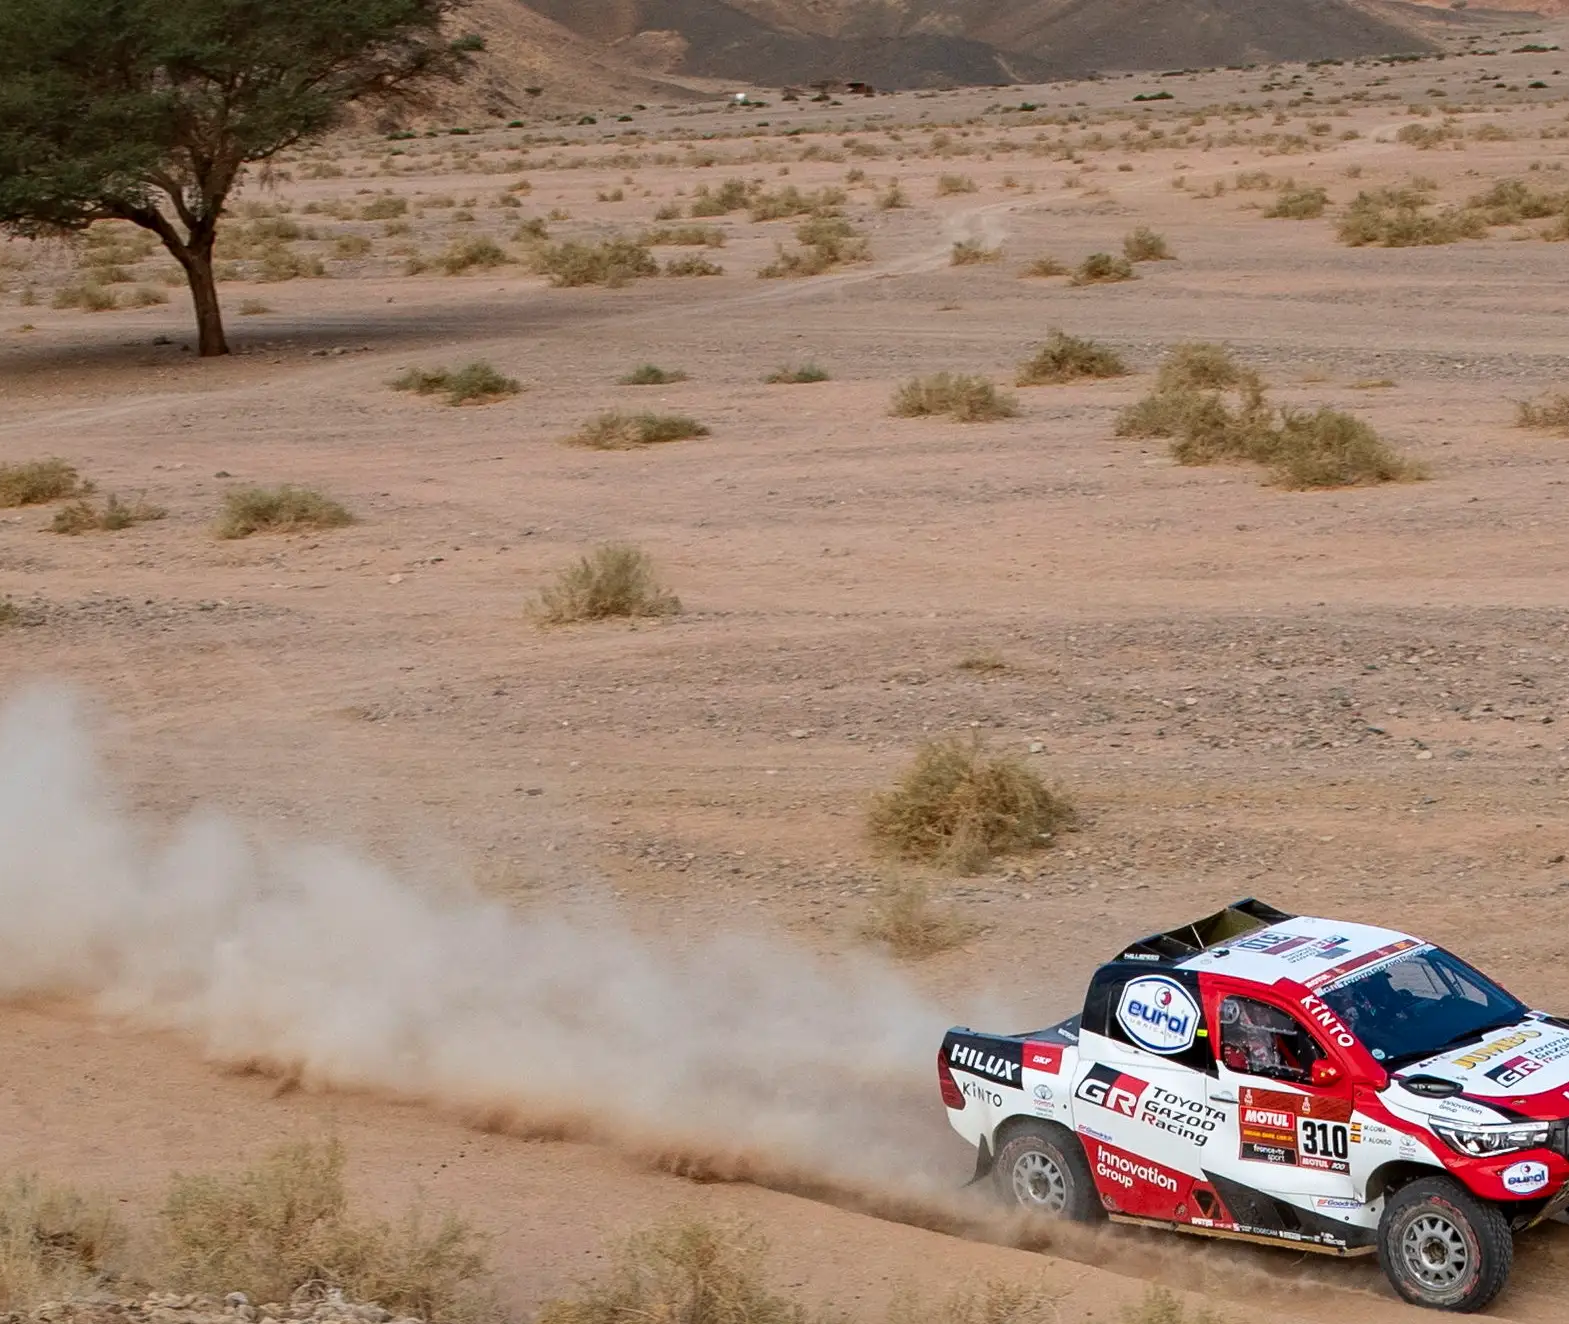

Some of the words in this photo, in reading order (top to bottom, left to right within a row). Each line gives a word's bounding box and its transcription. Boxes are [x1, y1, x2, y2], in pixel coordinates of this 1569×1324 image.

[1127, 999, 1189, 1036] eurol
[950, 1043, 1020, 1080] HILUX
[1452, 1030, 1542, 1070] JUMBO
[1495, 1058, 1544, 1088] GR
[1077, 1078, 1137, 1116] GR
[1152, 1086, 1227, 1122] TOYOTA
[1141, 1112, 1209, 1147] Racing
[1144, 1100, 1216, 1132] GAZOO
[1244, 1109, 1289, 1127] MOTUL
[1302, 1120, 1348, 1160] 310
[1097, 1163, 1133, 1188] Group
[1302, 1157, 1329, 1168] MOTUL
[1508, 1170, 1545, 1185] eurol
